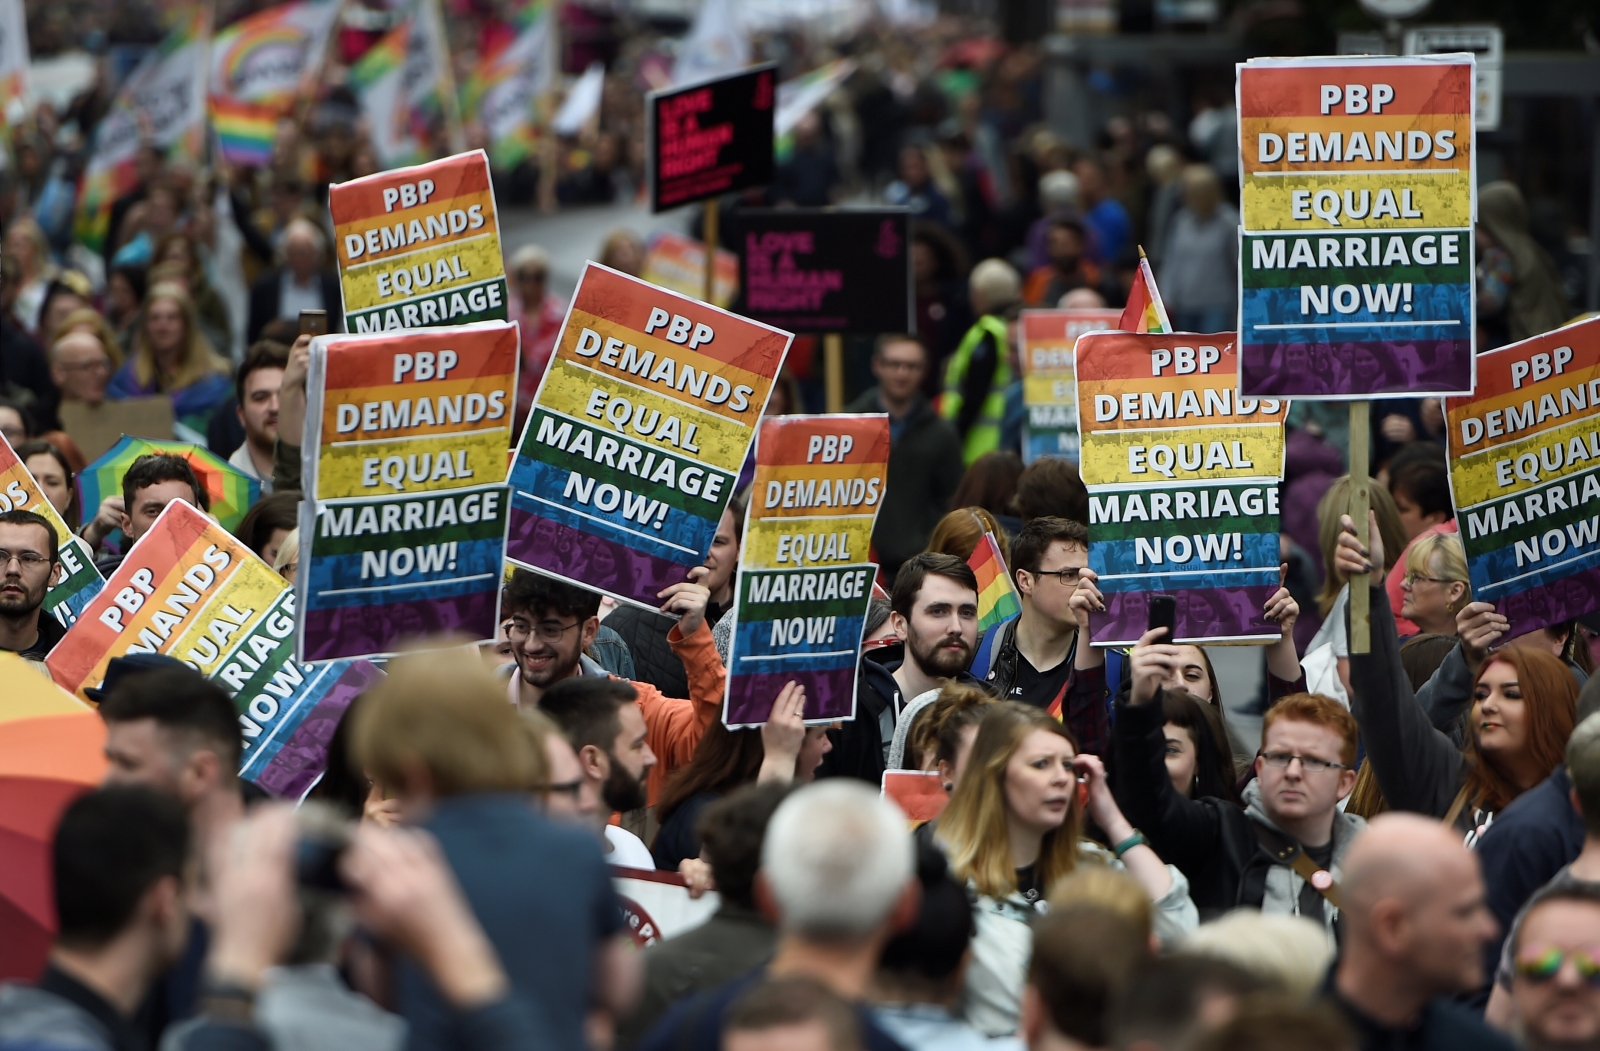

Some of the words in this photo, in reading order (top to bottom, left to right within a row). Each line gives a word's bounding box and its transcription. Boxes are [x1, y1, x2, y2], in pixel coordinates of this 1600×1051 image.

[1320, 83, 1395, 114] PBP
[1258, 129, 1456, 163] DEMANDS
[383, 178, 435, 213] PBP
[1291, 188, 1421, 225] EQUAL
[344, 204, 485, 259] DEMANDS
[1252, 234, 1460, 269] MARRIAGE
[376, 255, 469, 298] EQUAL
[355, 283, 502, 334] MARRIAGE
[1301, 283, 1413, 315] NOW!
[644, 306, 715, 351] PBP
[393, 350, 458, 383] PBP
[574, 327, 754, 413] DEMANDS
[1151, 346, 1220, 376] PBP
[1510, 345, 1573, 389] PBP
[336, 390, 506, 433] DEMANDS
[585, 388, 700, 453] EQUAL
[1094, 388, 1280, 422] DEMANDS
[1460, 377, 1600, 446] DEMAND
[535, 415, 726, 503] MARRIAGE
[806, 434, 853, 463] PBP
[1127, 440, 1252, 478] EQUAL
[361, 450, 473, 490] EQUAL
[562, 472, 670, 531] NOW!
[764, 477, 880, 509] DEMANDS
[1088, 487, 1280, 525] MARRIAGE
[1467, 472, 1600, 540] MARRIA
[320, 491, 500, 538] MARRIAGE
[360, 541, 458, 579] NOW!
[776, 532, 850, 567] EQUAL
[1135, 532, 1242, 565] NOW!
[1514, 514, 1600, 567] NOW
[99, 567, 154, 633] PBP
[126, 544, 231, 656] MANDS
[748, 570, 867, 604] MARRIAGE
[184, 604, 254, 671] UAL
[219, 593, 295, 699] RIAGE
[770, 616, 836, 646] NOW!
